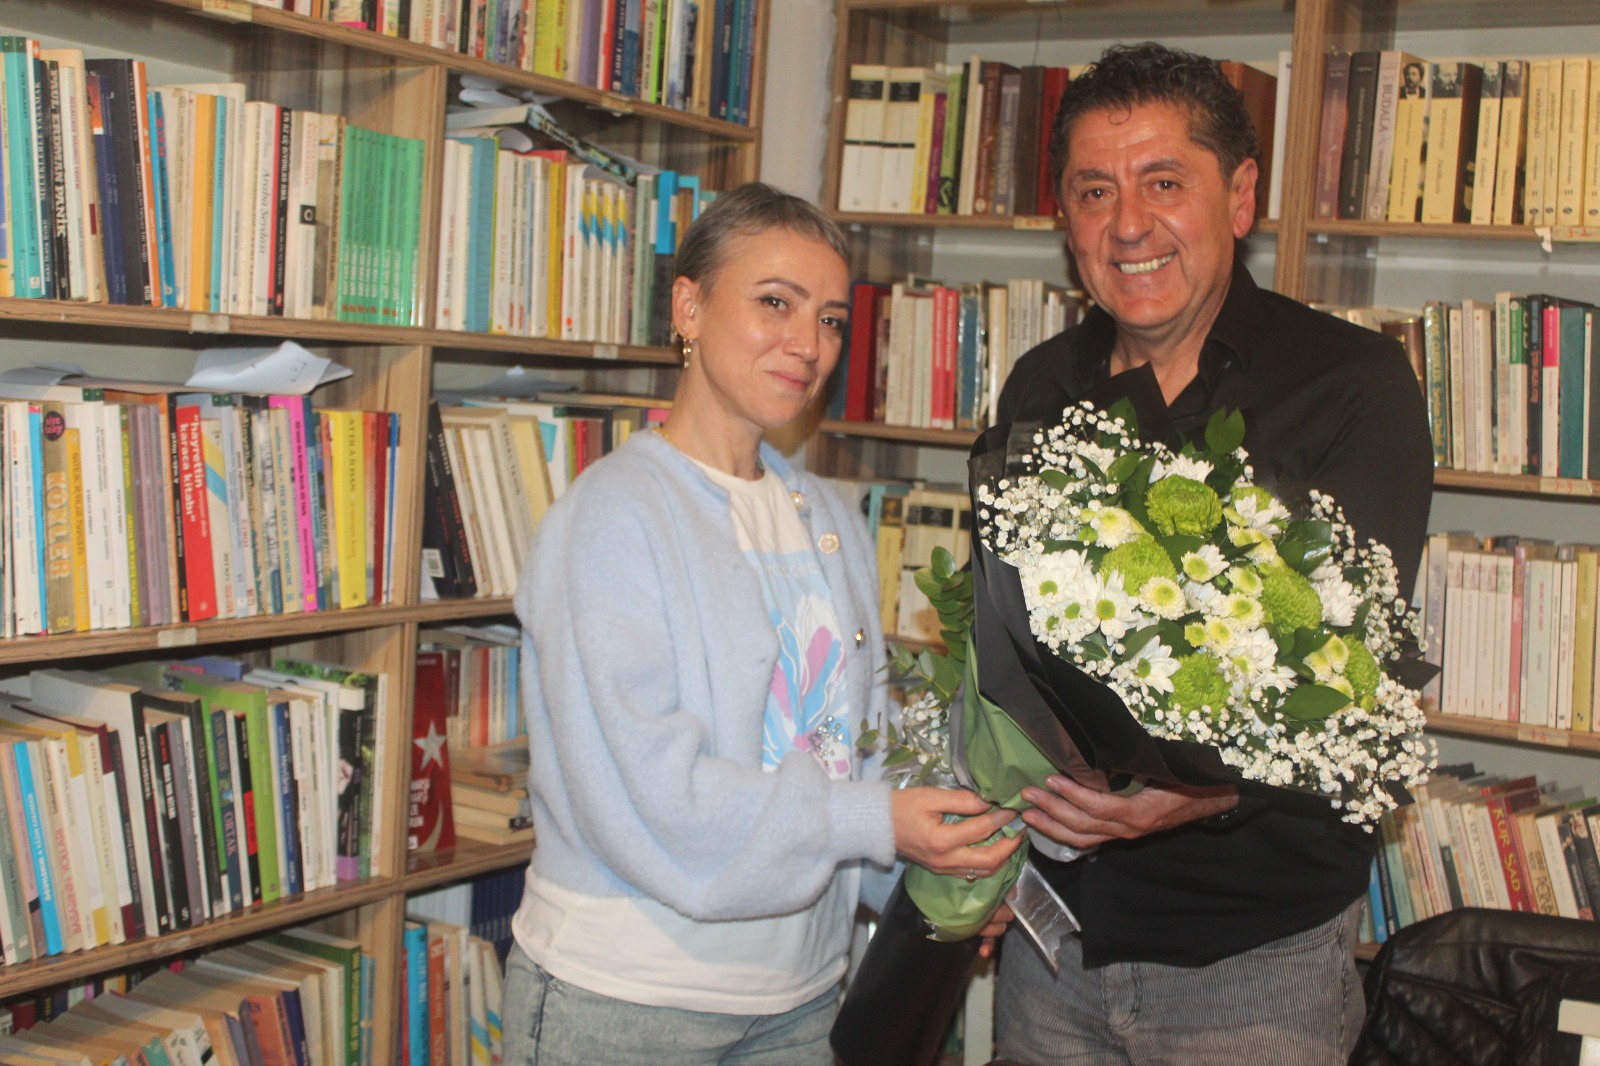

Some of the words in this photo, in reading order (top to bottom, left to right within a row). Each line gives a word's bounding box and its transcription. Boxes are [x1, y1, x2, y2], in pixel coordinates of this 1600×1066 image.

[50, 69, 61, 110] PAUL
[1379, 84, 1394, 133] BUDALA
[52, 113, 65, 183] ERDMAN
[261, 168, 271, 207] Araba
[180, 423, 192, 470] karaca
[502, 423, 513, 461] KEMAL
[55, 828, 72, 873] YOLLARI
[223, 811, 236, 857] ORTAK
